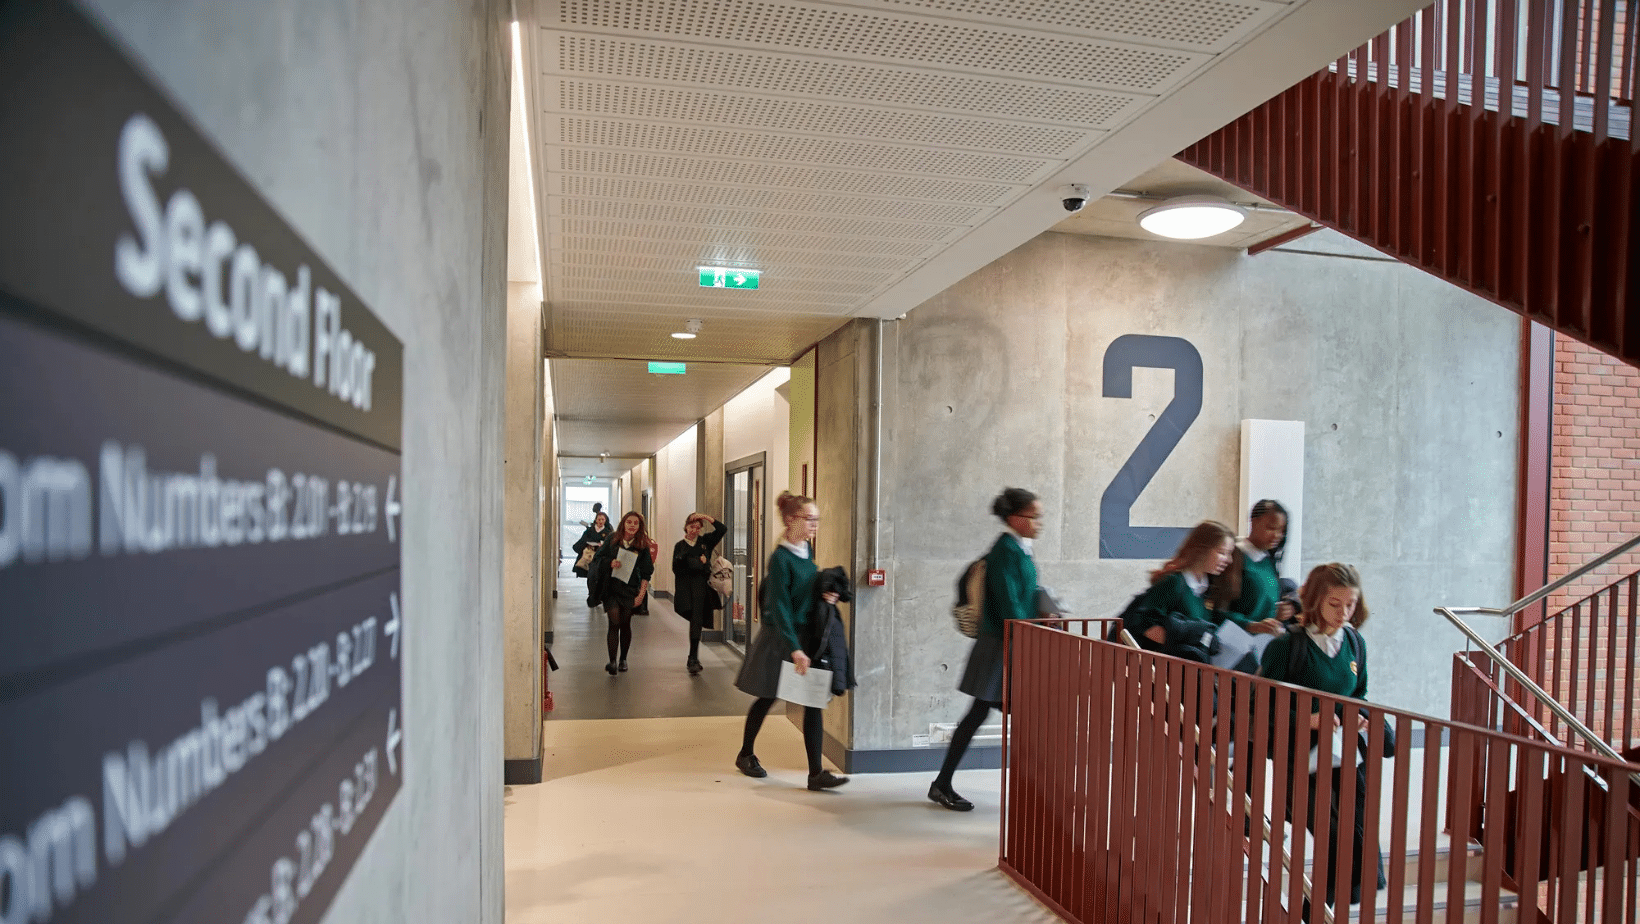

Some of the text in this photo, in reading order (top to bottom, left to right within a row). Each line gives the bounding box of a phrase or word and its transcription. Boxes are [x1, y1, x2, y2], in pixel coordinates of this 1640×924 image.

[114, 112, 375, 411] Second Floor
[100, 440, 265, 556] Numbers
[1100, 333, 1204, 559] 2
[103, 691, 268, 868] Numbers
